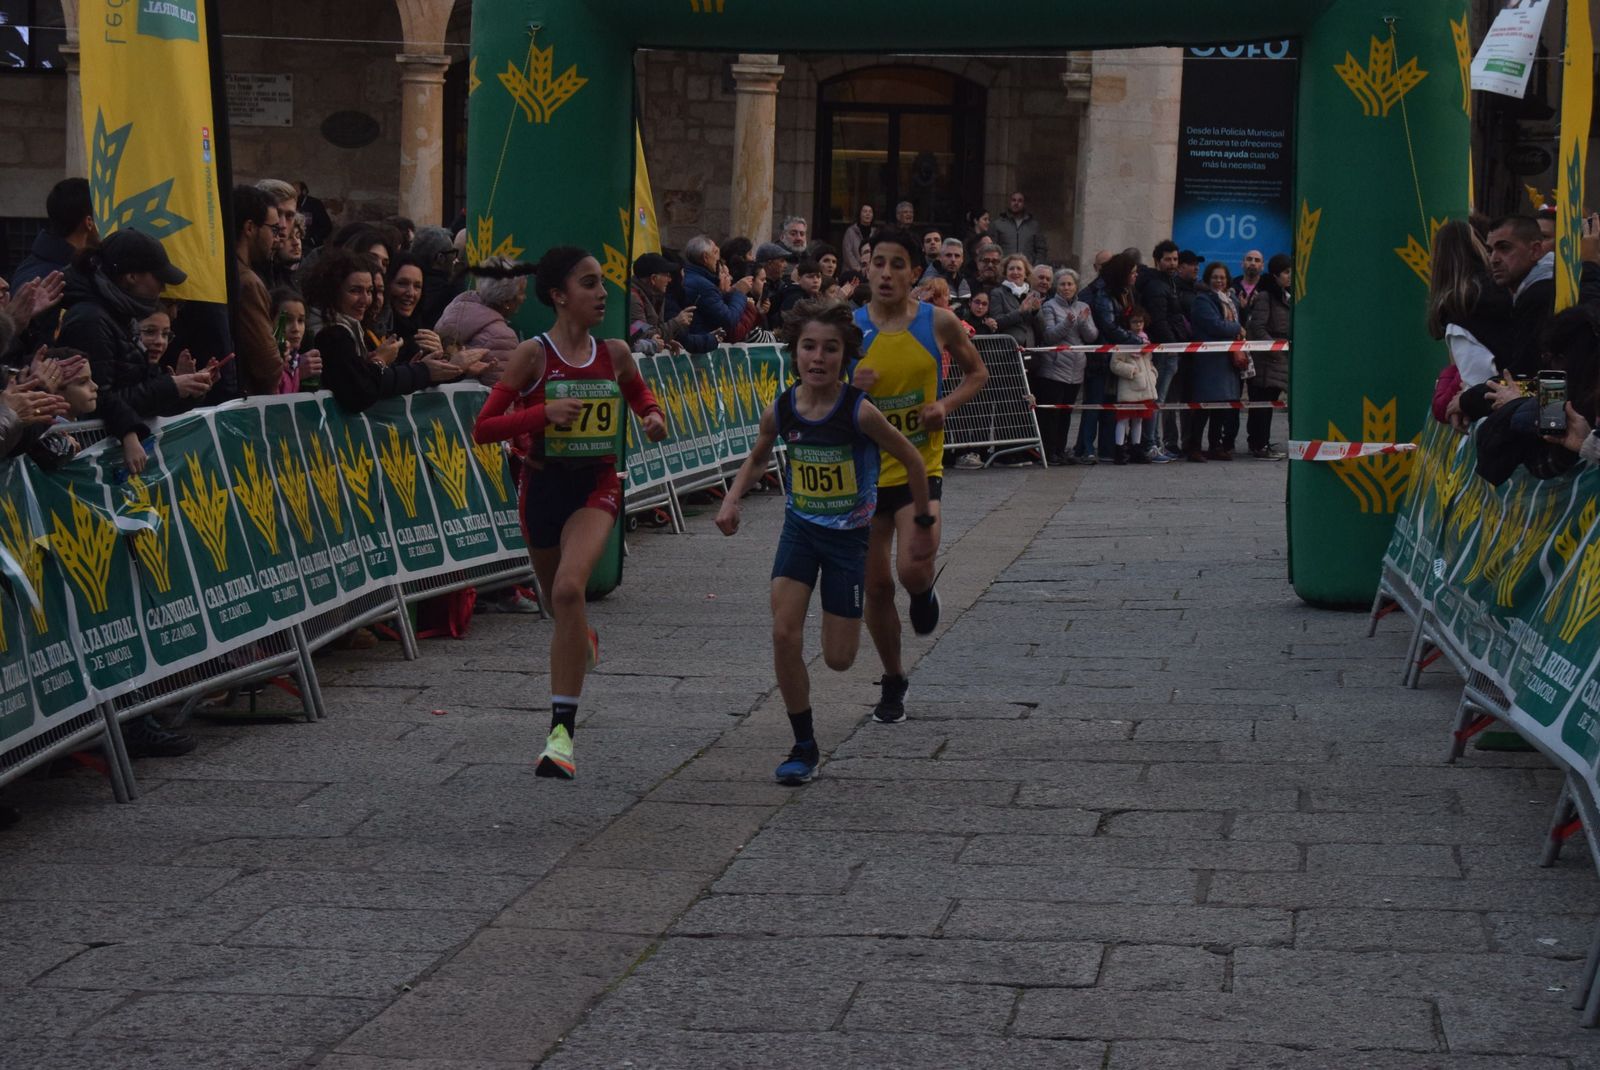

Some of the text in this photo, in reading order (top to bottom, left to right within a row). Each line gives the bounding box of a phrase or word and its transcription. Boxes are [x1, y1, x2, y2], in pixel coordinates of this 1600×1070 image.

[1186, 127, 1212, 135] Desde
[1213, 127, 1219, 135] la
[1247, 128, 1285, 138] Municipal
[1188, 138, 1282, 148] de Zamora te ofrecemos
[1220, 161, 1228, 169] la
[1229, 162, 1266, 170] necesitas
[1224, 150, 1249, 159] ayuda
[1249, 151, 1279, 159] cuando
[1204, 213, 1257, 240] 016
[555, 402, 611, 432] 79
[568, 441, 613, 451] CAJA RURAL
[798, 464, 843, 491] 1051
[396, 527, 415, 545] CAJA
[413, 523, 438, 543] RURAL
[443, 512, 491, 537] CAJA RURAL
[456, 537, 465, 548] DE
[204, 584, 228, 609] CAJA
[80, 615, 138, 655] AJA RURAL
[45, 640, 75, 669] RURA
[1541, 651, 1582, 692] RURAL
